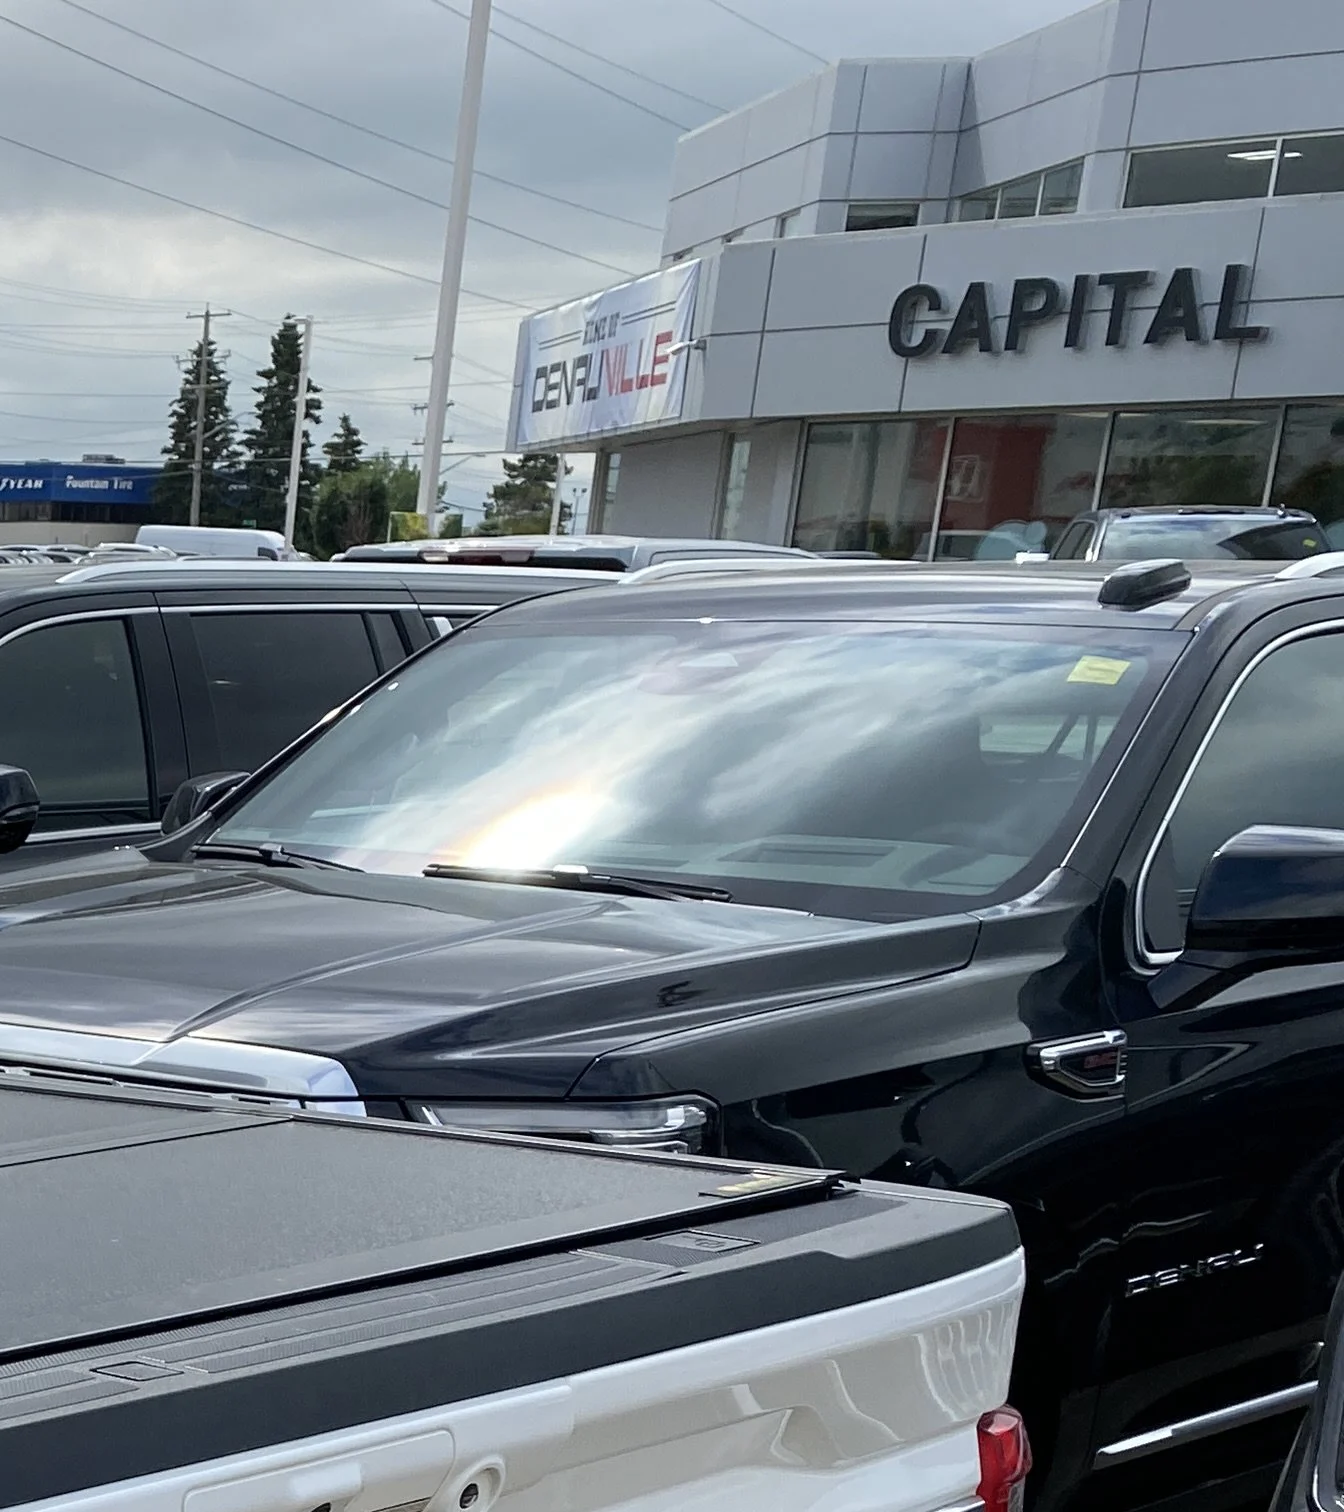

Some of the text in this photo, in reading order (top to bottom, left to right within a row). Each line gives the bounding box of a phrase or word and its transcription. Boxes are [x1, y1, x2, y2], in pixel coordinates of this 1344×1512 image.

[888, 263, 1269, 358] CAPITAL
[65, 475, 134, 490] Fountain Tire
